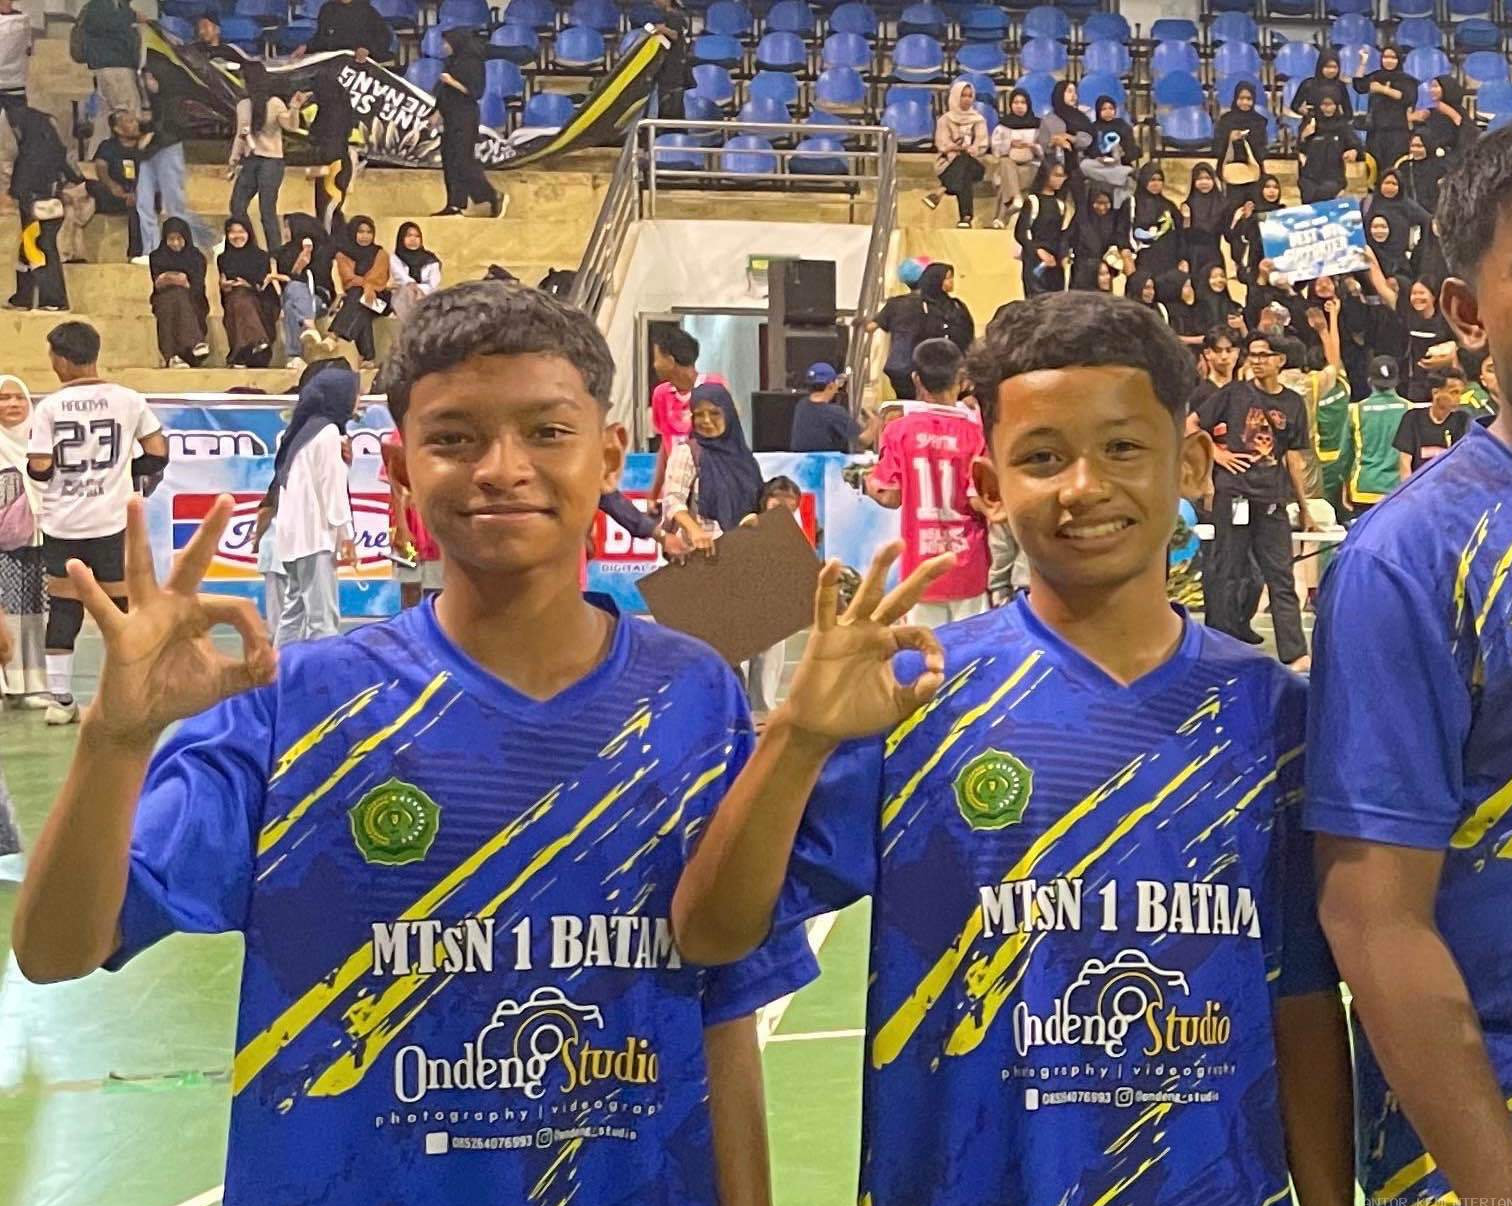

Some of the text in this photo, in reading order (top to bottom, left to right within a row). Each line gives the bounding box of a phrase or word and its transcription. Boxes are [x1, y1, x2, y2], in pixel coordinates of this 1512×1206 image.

[54, 418, 122, 473] 23
[912, 457, 971, 521] 11
[1098, 879, 1119, 932] 1
[1135, 880, 1262, 939] BATAM
[371, 917, 495, 977] MTsN
[511, 915, 533, 971] 1
[1143, 1000, 1231, 1057] Studio
[395, 1036, 660, 1103] Ondeng Studio
[374, 1106, 528, 1128] photography
